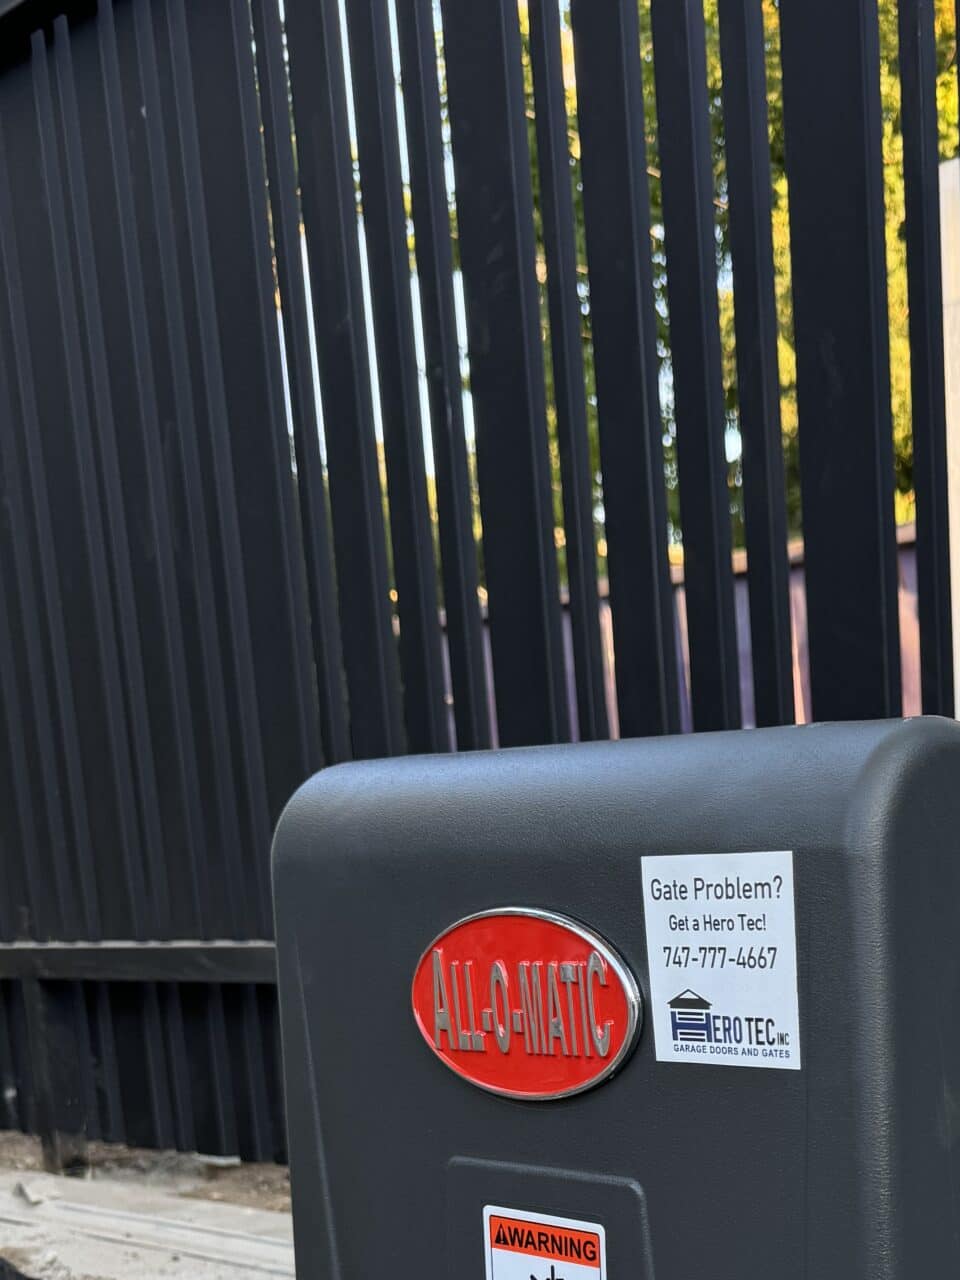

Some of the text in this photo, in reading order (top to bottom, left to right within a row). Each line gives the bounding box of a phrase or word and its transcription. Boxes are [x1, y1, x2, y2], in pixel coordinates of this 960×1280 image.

[650, 875, 783, 901] Gate Problem?
[669, 914, 766, 931] Get a Hero Tec!
[663, 946, 777, 969] 747-777-4667
[432, 948, 614, 1058] ALL-O-MATIC
[745, 1017, 776, 1046] TEC
[777, 1033, 790, 1046] INC
[673, 1044, 790, 1059] GARAGE DOORS AND GATES
[508, 1226, 597, 1261] WARNING
